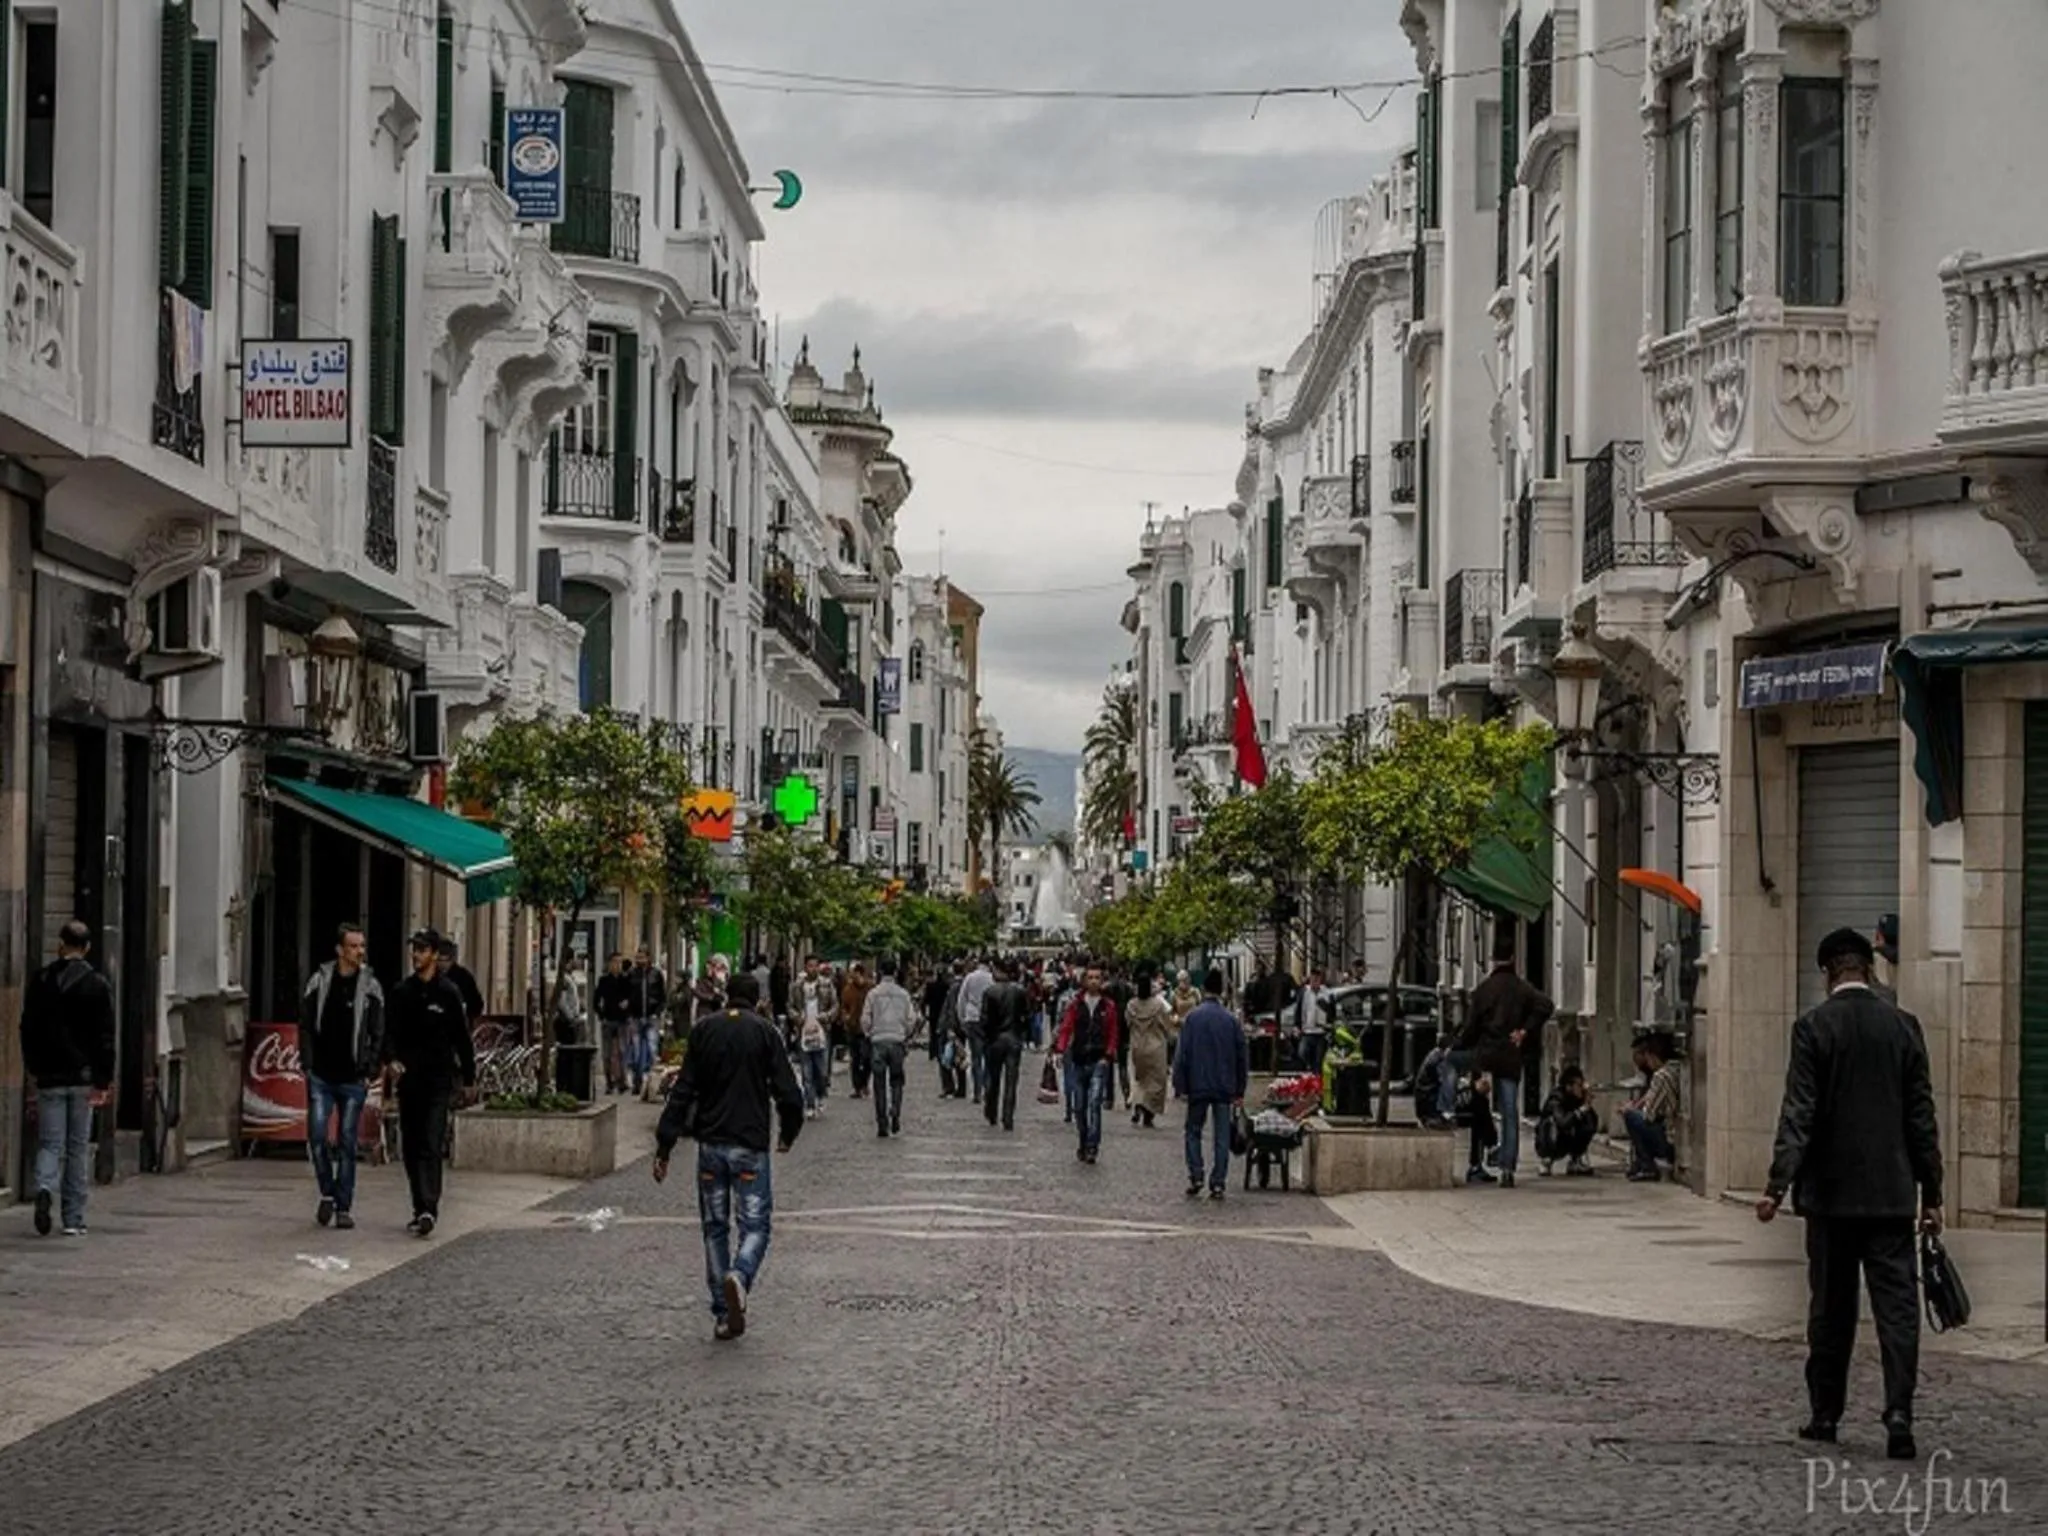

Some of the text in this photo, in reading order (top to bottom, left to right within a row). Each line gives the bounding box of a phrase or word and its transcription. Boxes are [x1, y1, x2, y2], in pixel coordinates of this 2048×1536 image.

[247, 345, 345, 385] فندق بيلباو
[246, 388, 346, 419] HOTEL BILBAO
